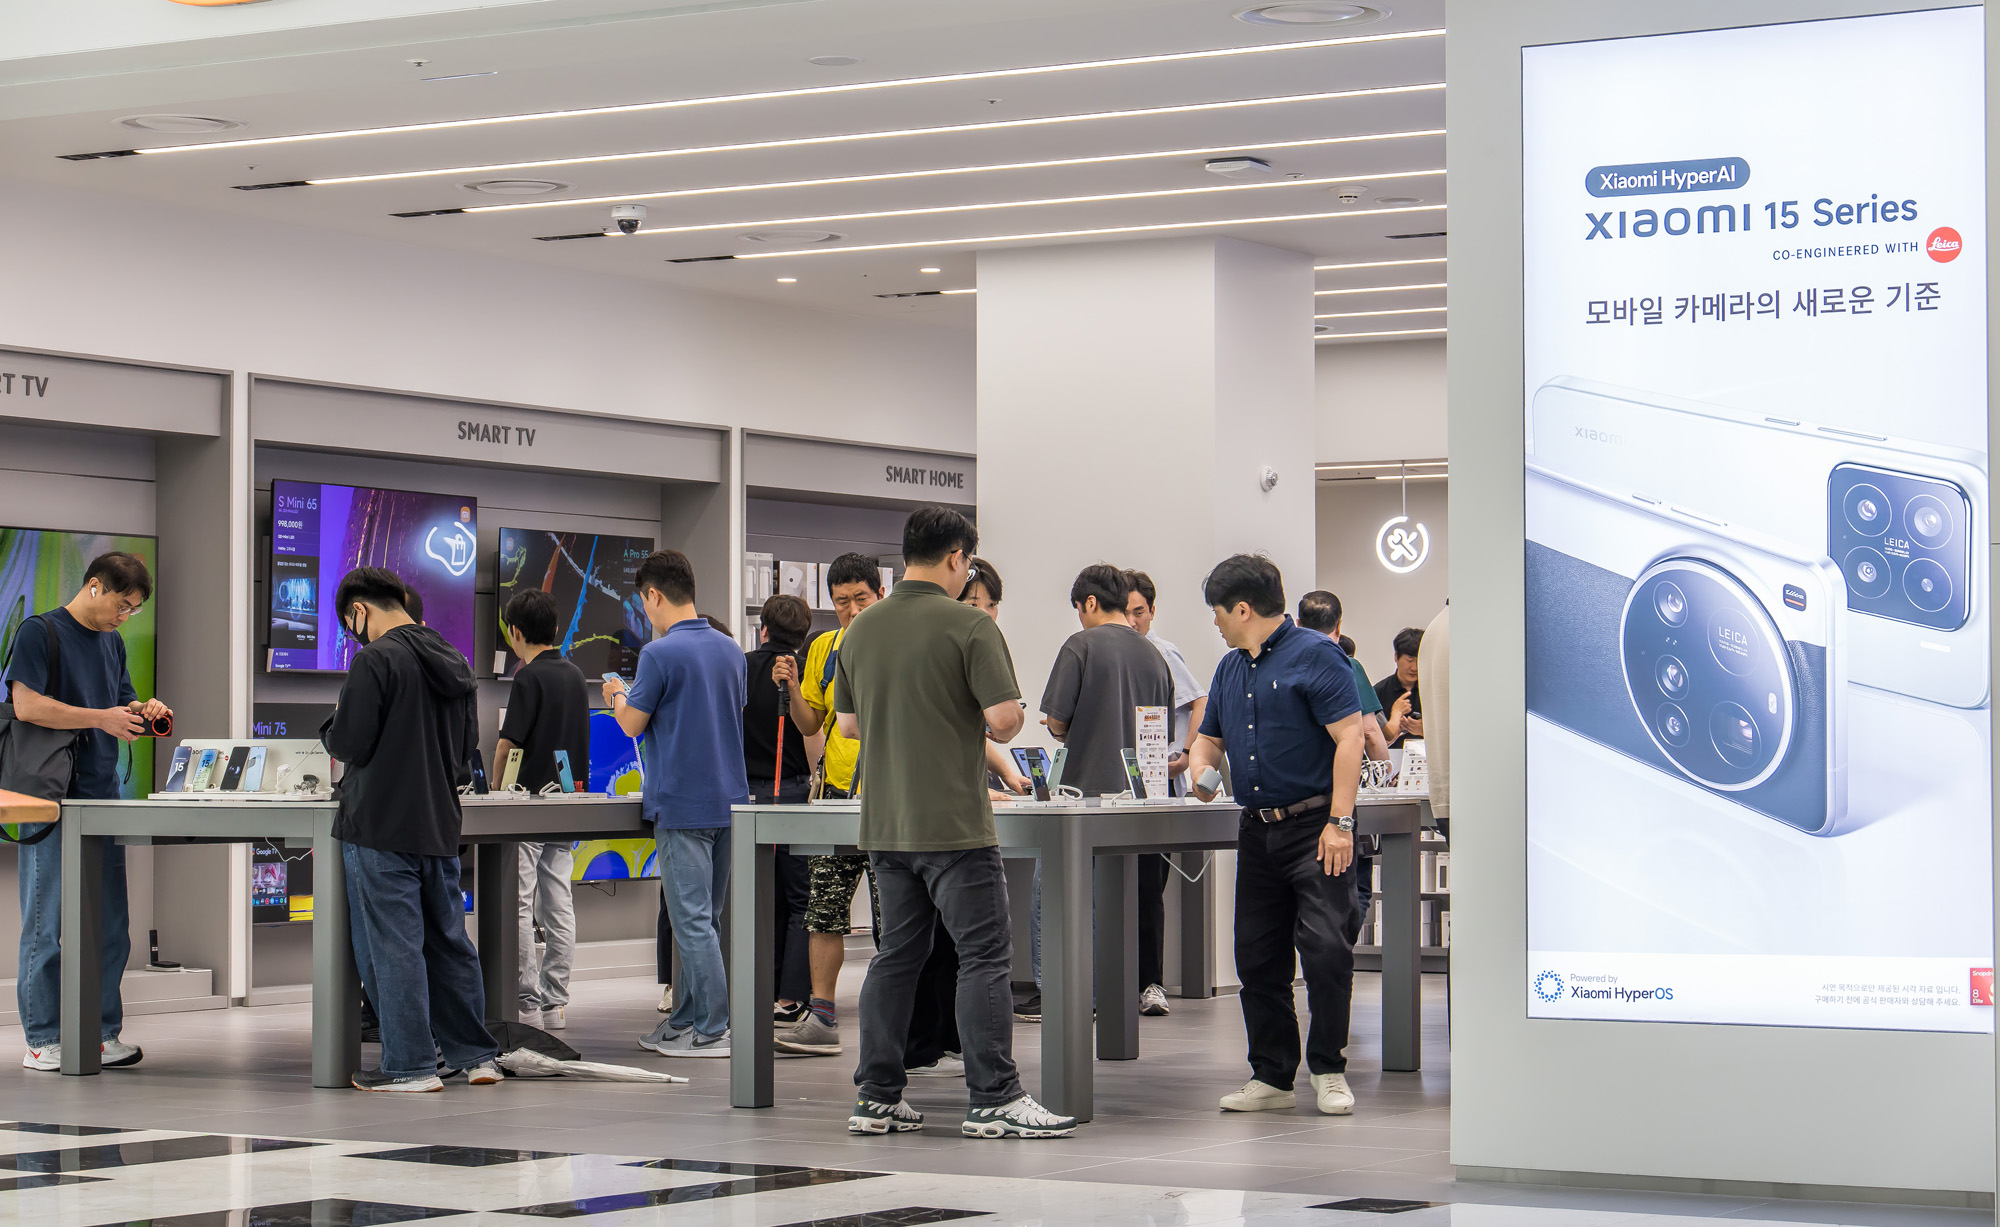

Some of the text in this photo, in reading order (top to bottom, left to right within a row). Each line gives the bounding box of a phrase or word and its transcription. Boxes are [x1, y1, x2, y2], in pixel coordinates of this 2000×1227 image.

[1600, 164, 1736, 190] Xiaomi HyperAI
[1764, 200, 1799, 230] 15
[1813, 193, 1918, 227] Series
[1772, 236, 1960, 261] CO-ENGINEERED WITH Leica
[1586, 281, 1942, 326] 모바일 카메라의 새로운 기준
[21, 374, 49, 398] TV
[458, 420, 537, 447] SMART TV
[885, 464, 964, 489] SMART HOME
[278, 496, 317, 509] S Mini 65
[1884, 536, 1910, 550] LEICA
[630, 549, 639, 558] Pro
[641, 550, 648, 558] 55
[1718, 626, 1748, 646] LEICA
[274, 722, 287, 736] 75
[175, 762, 185, 772] 15
[201, 759, 211, 768] 15
[256, 848, 271, 856] Google
[1570, 973, 1618, 984] Powered by
[1571, 986, 1674, 1003] Xiaomi HyperOS
